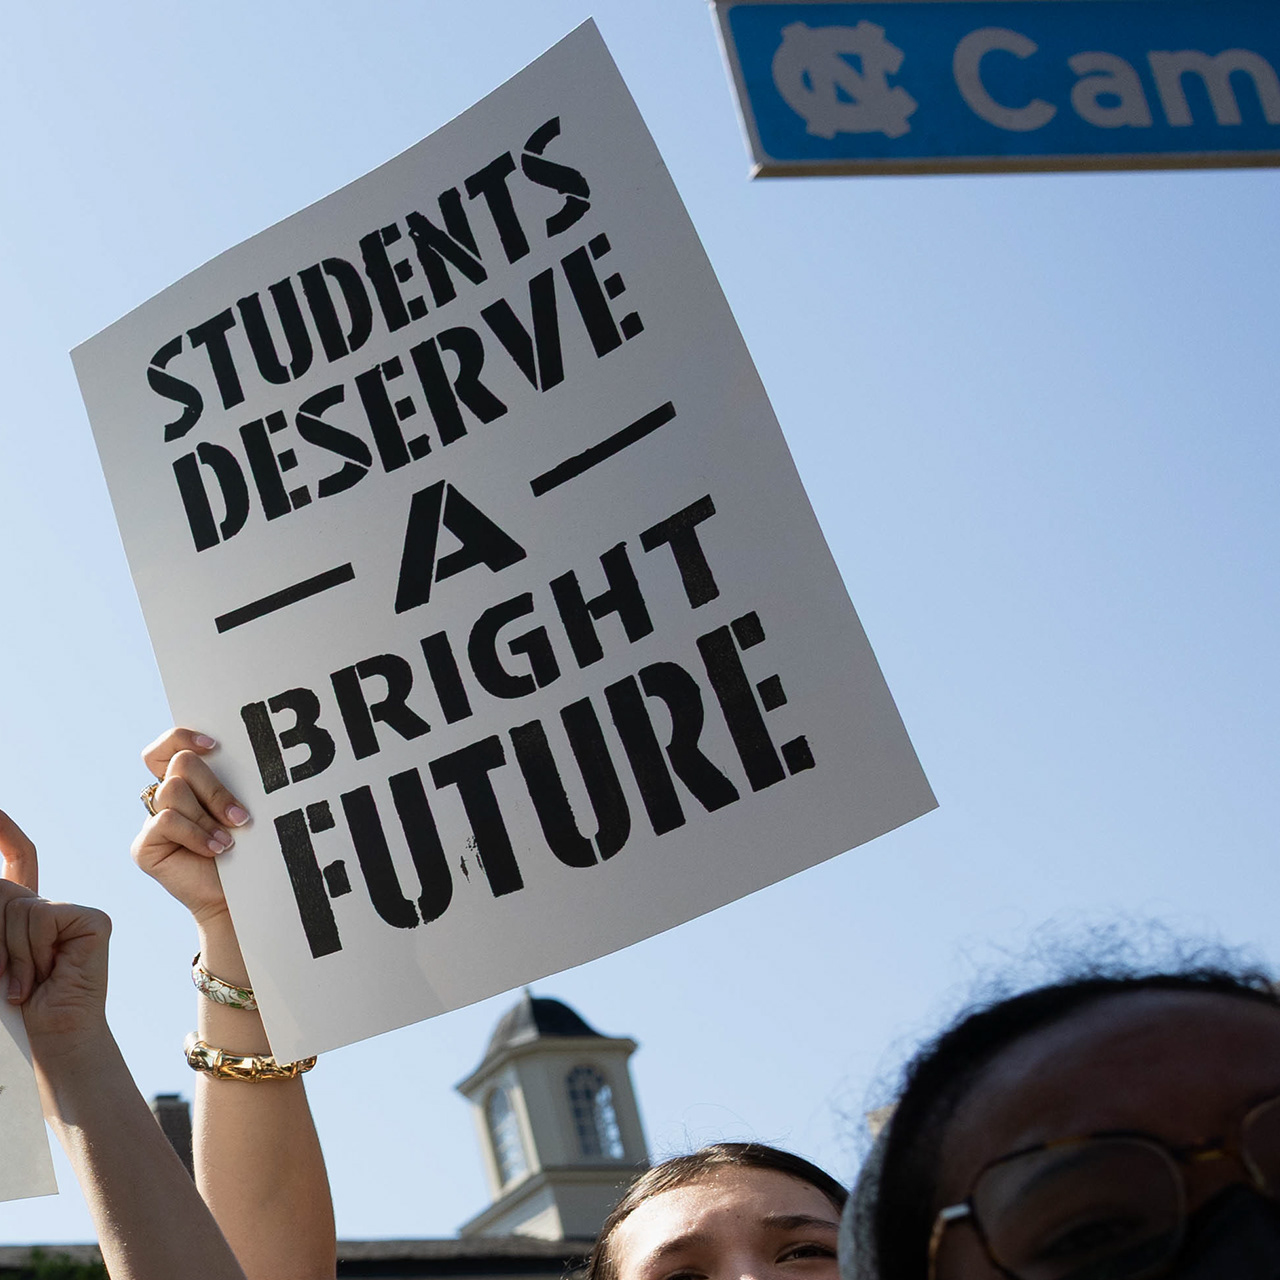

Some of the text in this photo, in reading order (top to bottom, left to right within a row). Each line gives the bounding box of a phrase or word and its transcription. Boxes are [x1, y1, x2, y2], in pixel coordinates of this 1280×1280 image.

[146, 115, 592, 444] STUDENTS
[172, 232, 646, 554] DESERVE
[240, 493, 721, 796] BRIGHT
[273, 610, 817, 960] FUTURE
